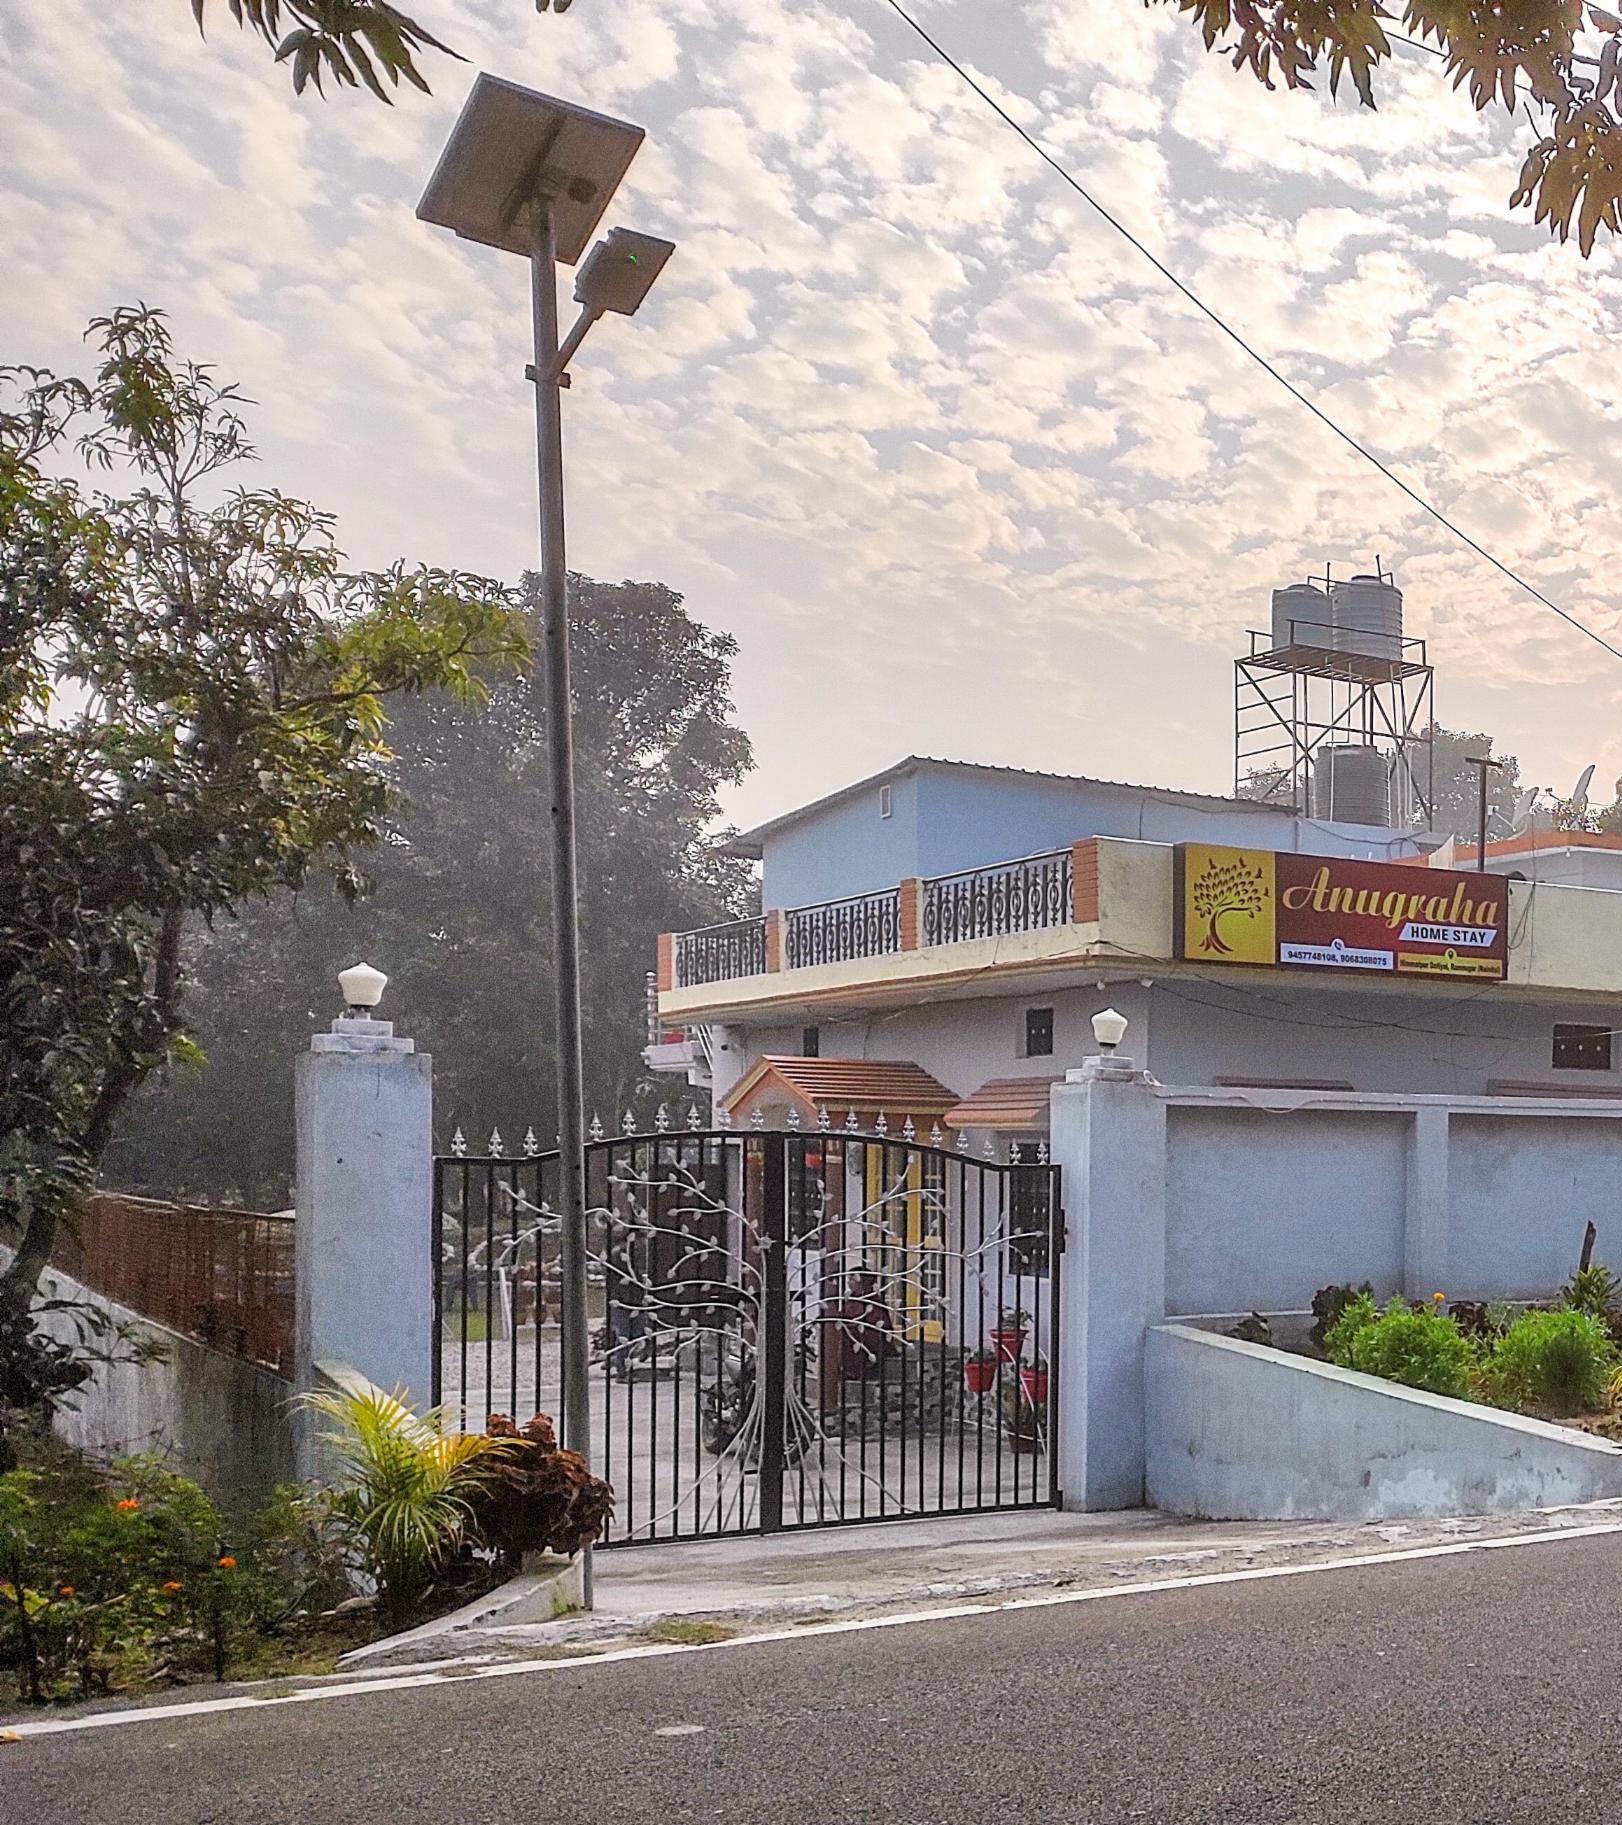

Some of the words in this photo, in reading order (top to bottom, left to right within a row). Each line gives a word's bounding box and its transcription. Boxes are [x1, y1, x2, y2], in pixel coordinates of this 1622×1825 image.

[1282, 866, 1499, 929] Anugraha
[1411, 926, 1449, 941] HOME
[1452, 928, 1487, 944] STAY
